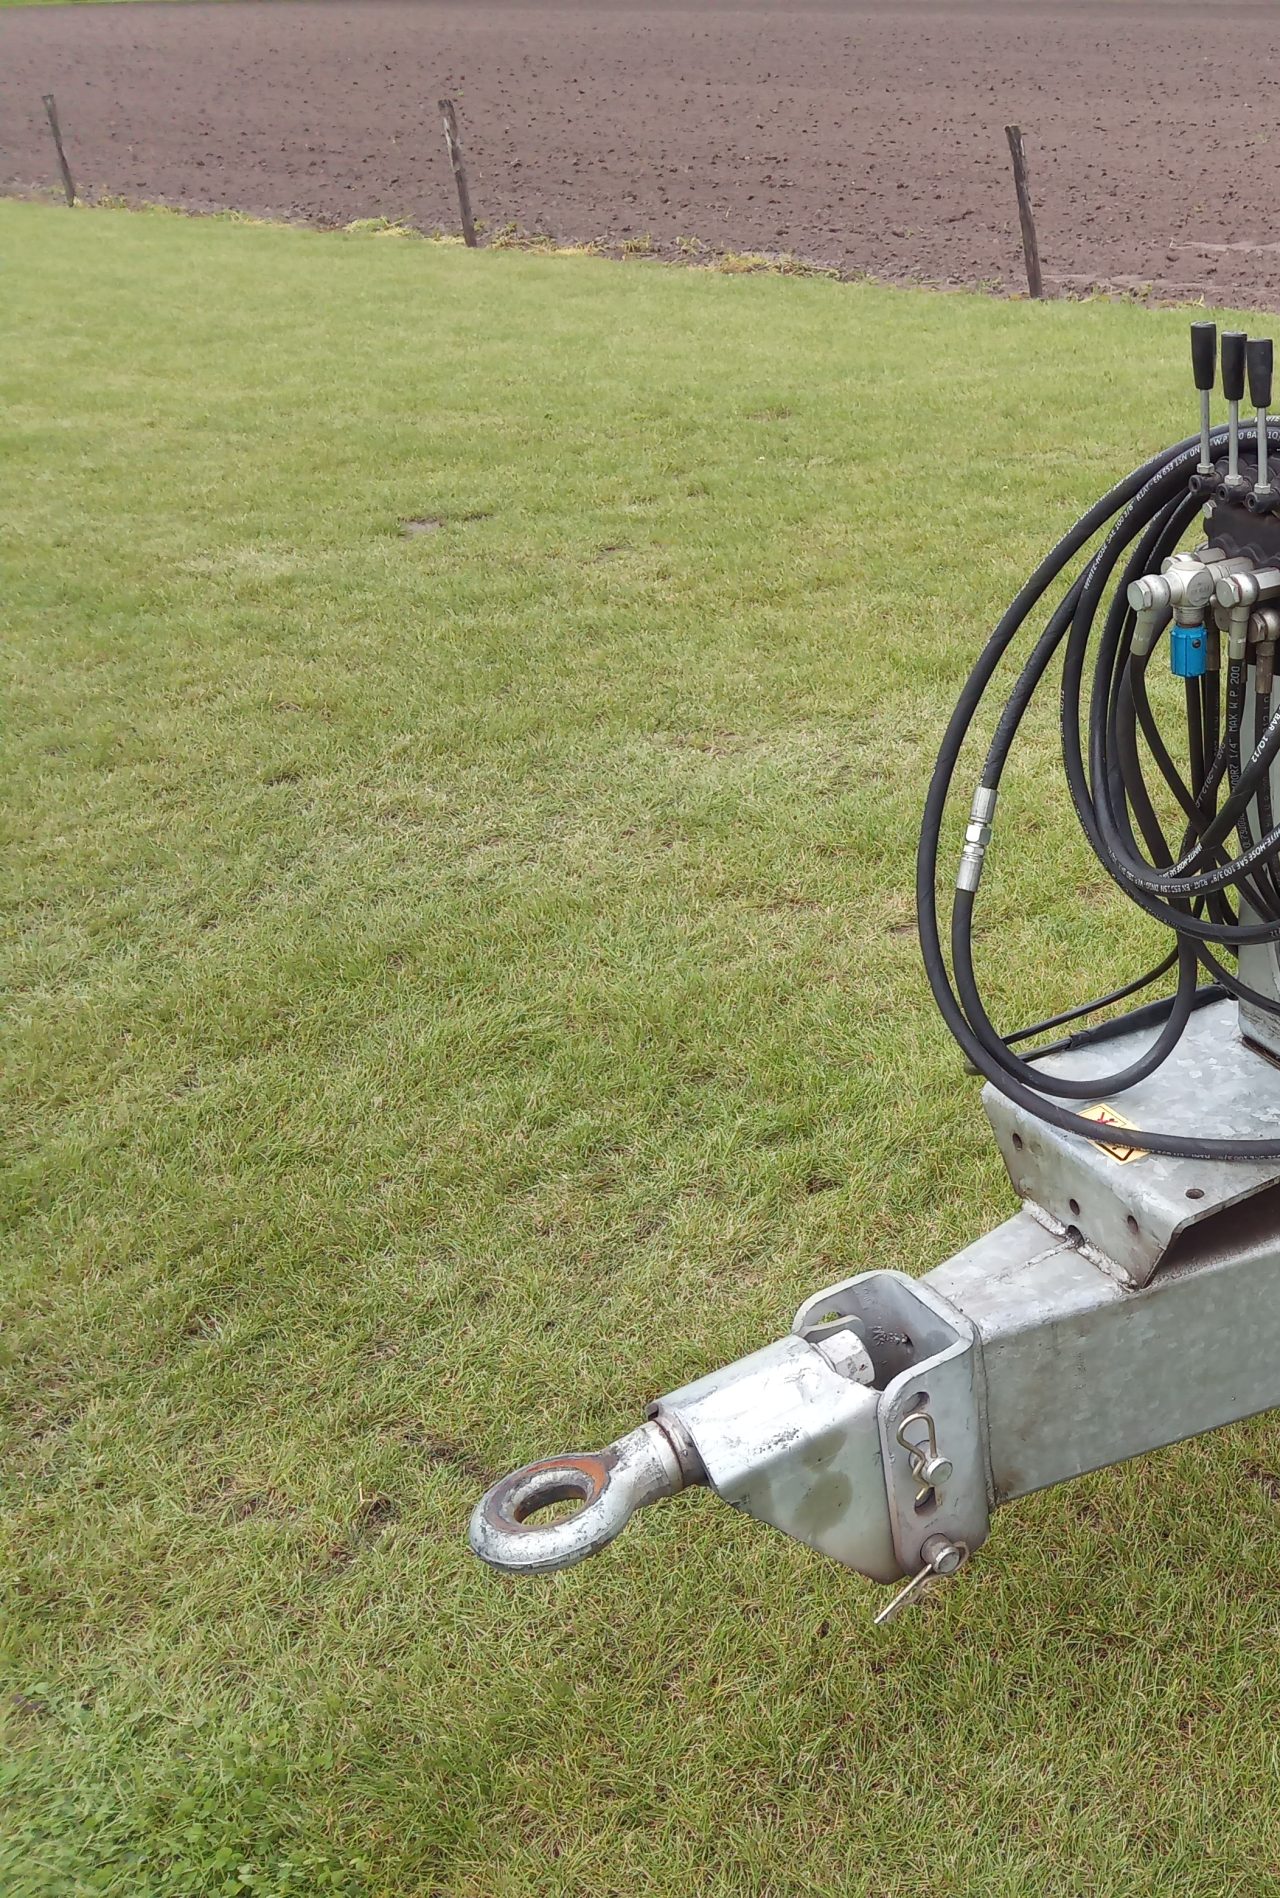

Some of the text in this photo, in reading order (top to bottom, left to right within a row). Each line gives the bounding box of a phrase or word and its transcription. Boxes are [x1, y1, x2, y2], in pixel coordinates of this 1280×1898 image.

[1230, 665, 1241, 685] 200
[1228, 713, 1239, 733] MAX
[1250, 735, 1269, 763] 1Q/12
[1237, 858, 1249, 871] SAE
